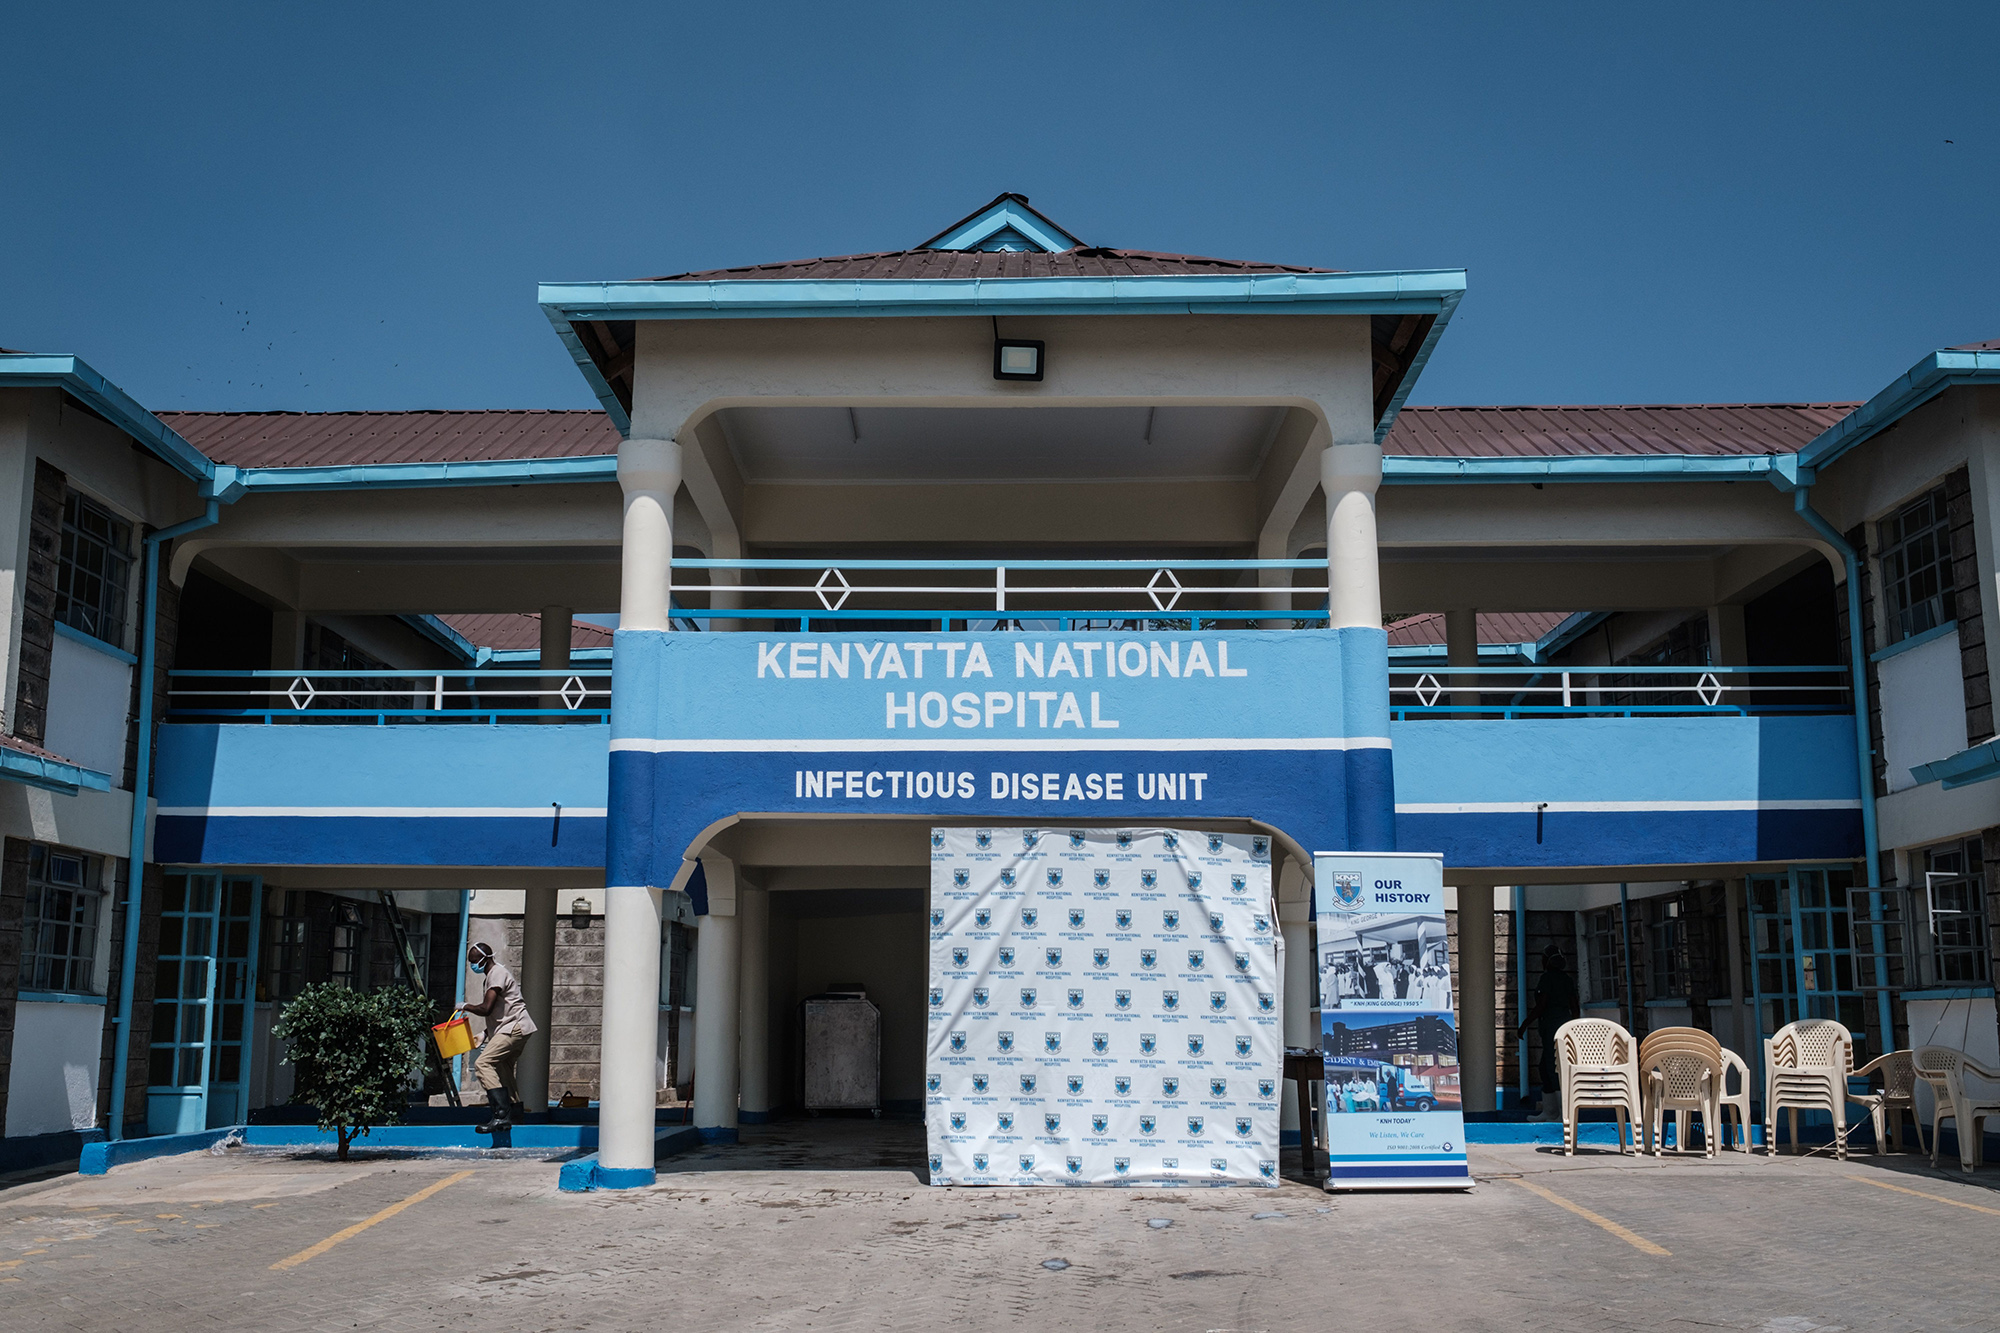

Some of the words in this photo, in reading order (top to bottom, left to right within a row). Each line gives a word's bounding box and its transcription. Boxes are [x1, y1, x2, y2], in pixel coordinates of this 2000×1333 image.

[757, 642, 994, 679] KENYATTA
[1014, 641, 1248, 678] NATIONAL
[886, 691, 1120, 729] HOSPITAL
[795, 771, 975, 799] INFECTIOUS
[991, 772, 1124, 801] DISEASE
[1137, 773, 1208, 801] UNIT
[1374, 879, 1402, 890] OUR
[1375, 893, 1431, 903] HISTORY
[1358, 1058, 1366, 1066] &
[1379, 1131, 1399, 1139] Listen,
